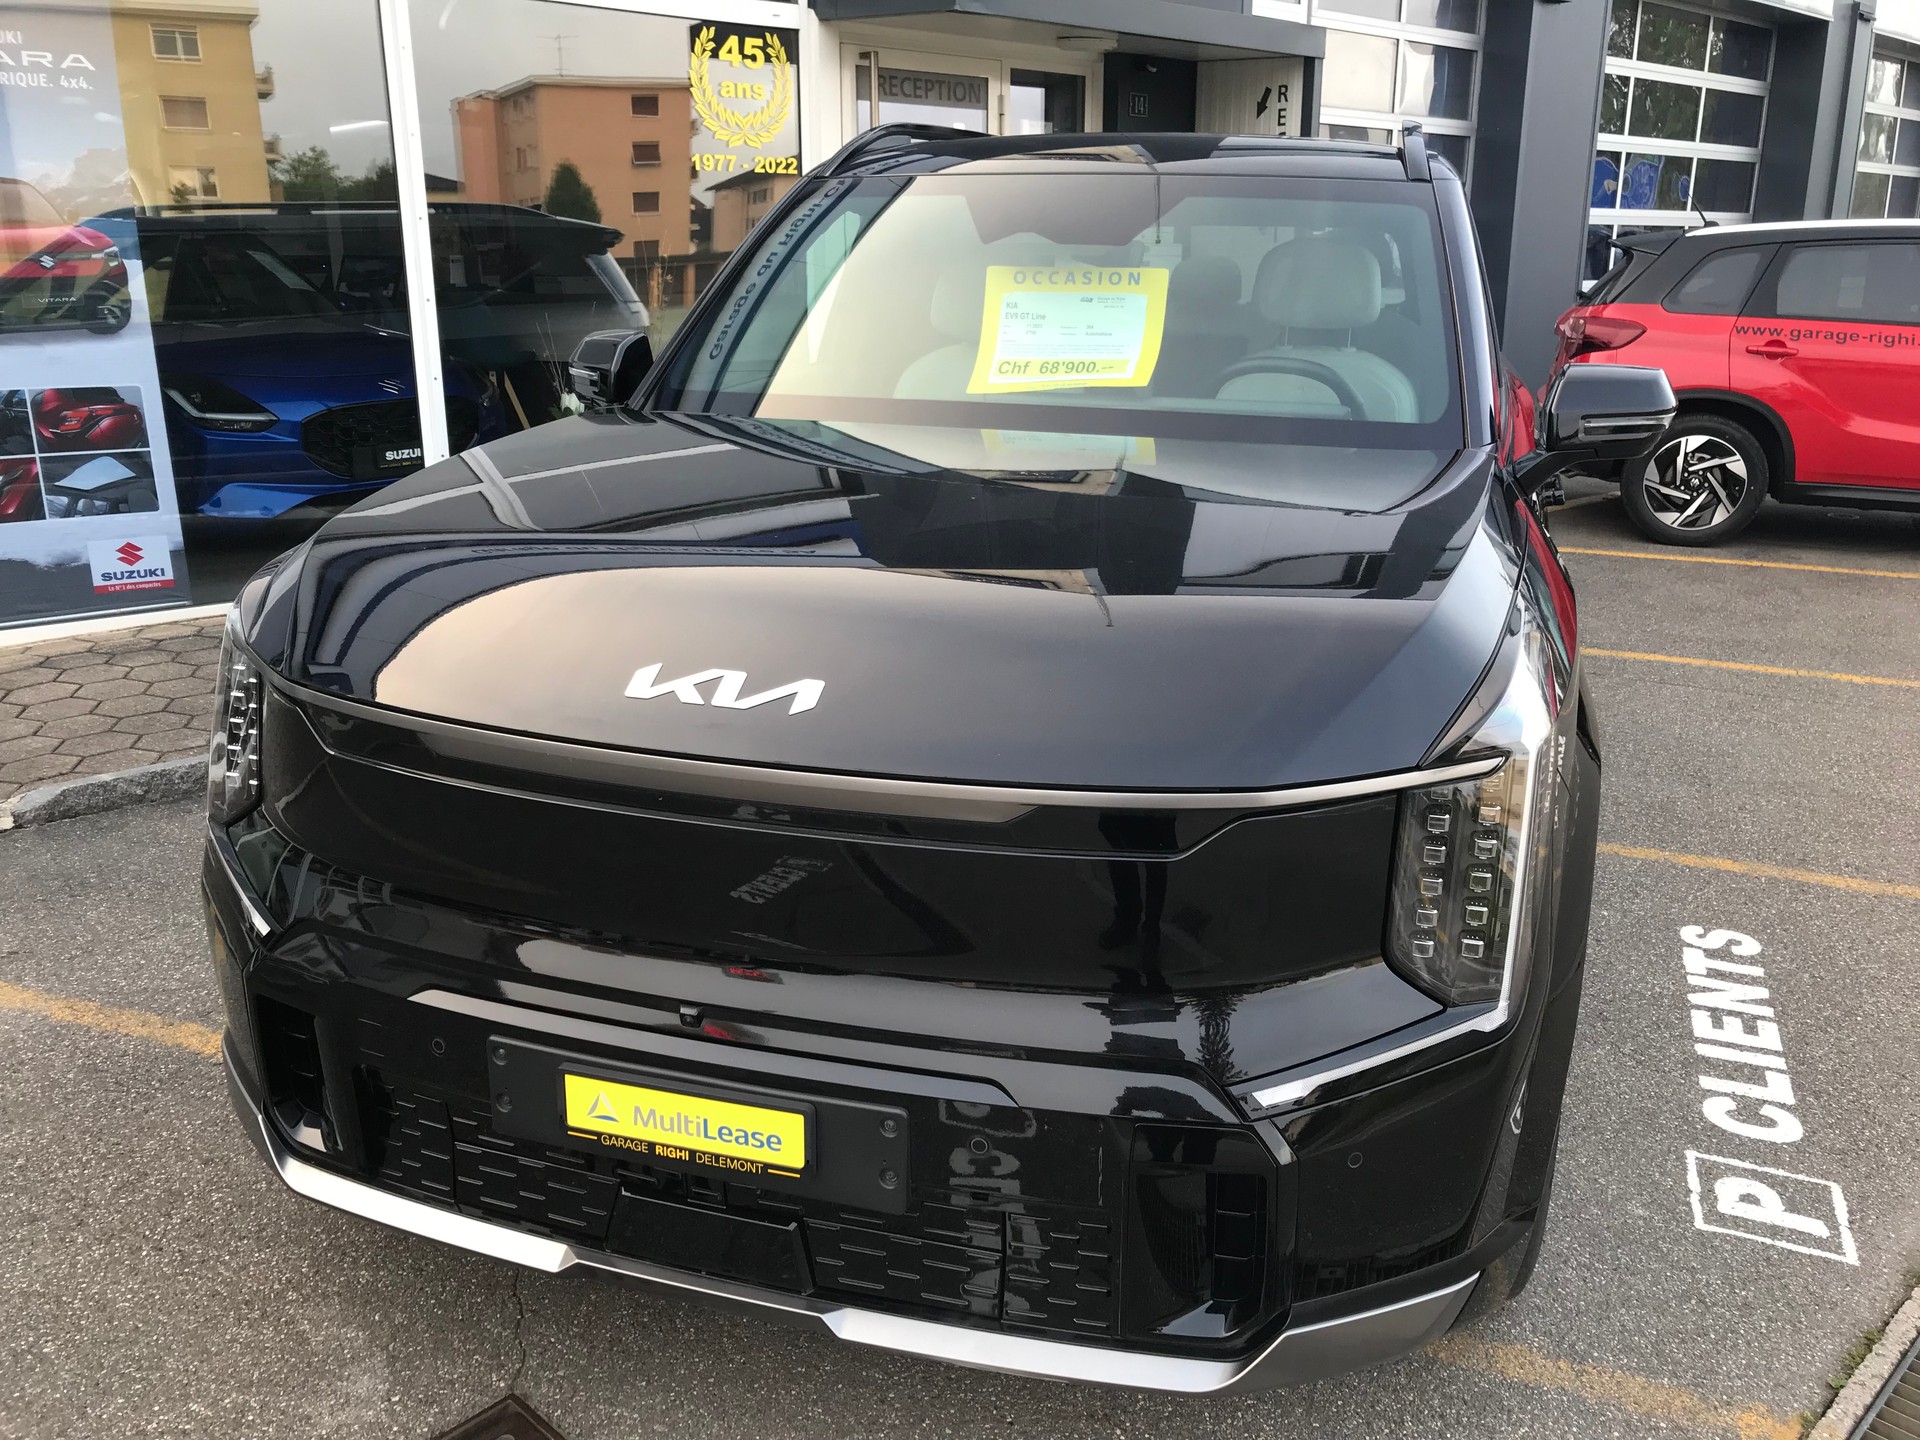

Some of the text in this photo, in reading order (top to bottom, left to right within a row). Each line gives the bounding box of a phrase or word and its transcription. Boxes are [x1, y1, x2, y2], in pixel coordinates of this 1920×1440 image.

[718, 35, 765, 69] 45
[60, 75, 93, 90] 4x4.
[721, 81, 766, 99] ans
[878, 75, 981, 104] RECEPTION
[1134, 97, 1144, 114] 14
[1277, 85, 1288, 136] RE
[691, 153, 736, 172] 1977
[754, 156, 798, 174] 2022
[1013, 271, 1141, 286] OCCASION
[1005, 312, 1018, 320] EV9
[1031, 313, 1046, 321] Line
[998, 361, 1031, 375] Chf
[101, 568, 165, 582] SUZUKI
[624, 662, 826, 716] KIA
[1680, 924, 1803, 1143] CLIENTS
[633, 1105, 782, 1152] MultiLease
[601, 1134, 763, 1174] GARAGE RIGHI DELEMONT
